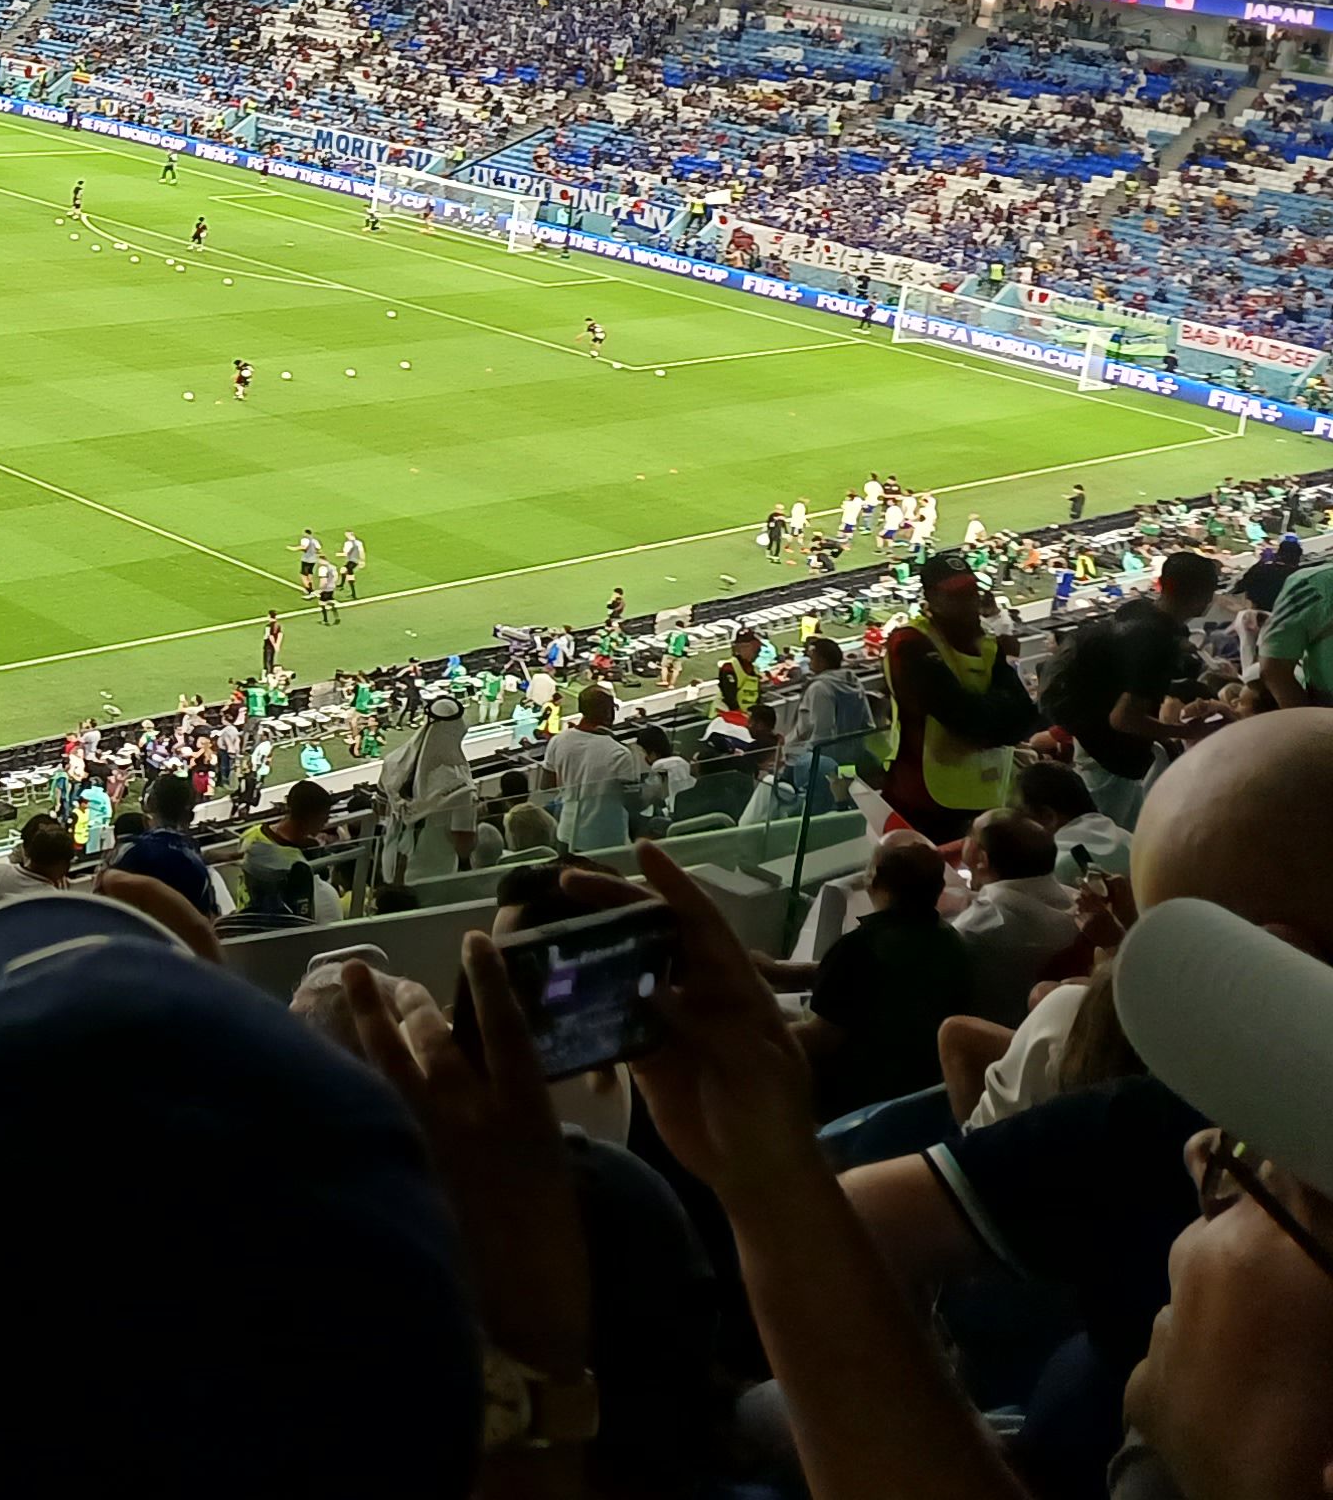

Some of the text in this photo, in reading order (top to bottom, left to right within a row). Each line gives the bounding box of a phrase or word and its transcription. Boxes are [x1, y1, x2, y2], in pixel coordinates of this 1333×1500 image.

[1244, 2, 1314, 26] JAPAN
[314, 129, 433, 171] MORIYSU
[160, 136, 187, 151] CUP
[247, 156, 299, 181] FOLOW
[569, 231, 598, 252] THE
[597, 240, 632, 262] FIFA
[632, 249, 691, 275] WORLD
[691, 260, 729, 284] CUP
[931, 321, 970, 343] FIFA
[971, 330, 1046, 363] WORLD
[1181, 324, 1221, 345] BAD
